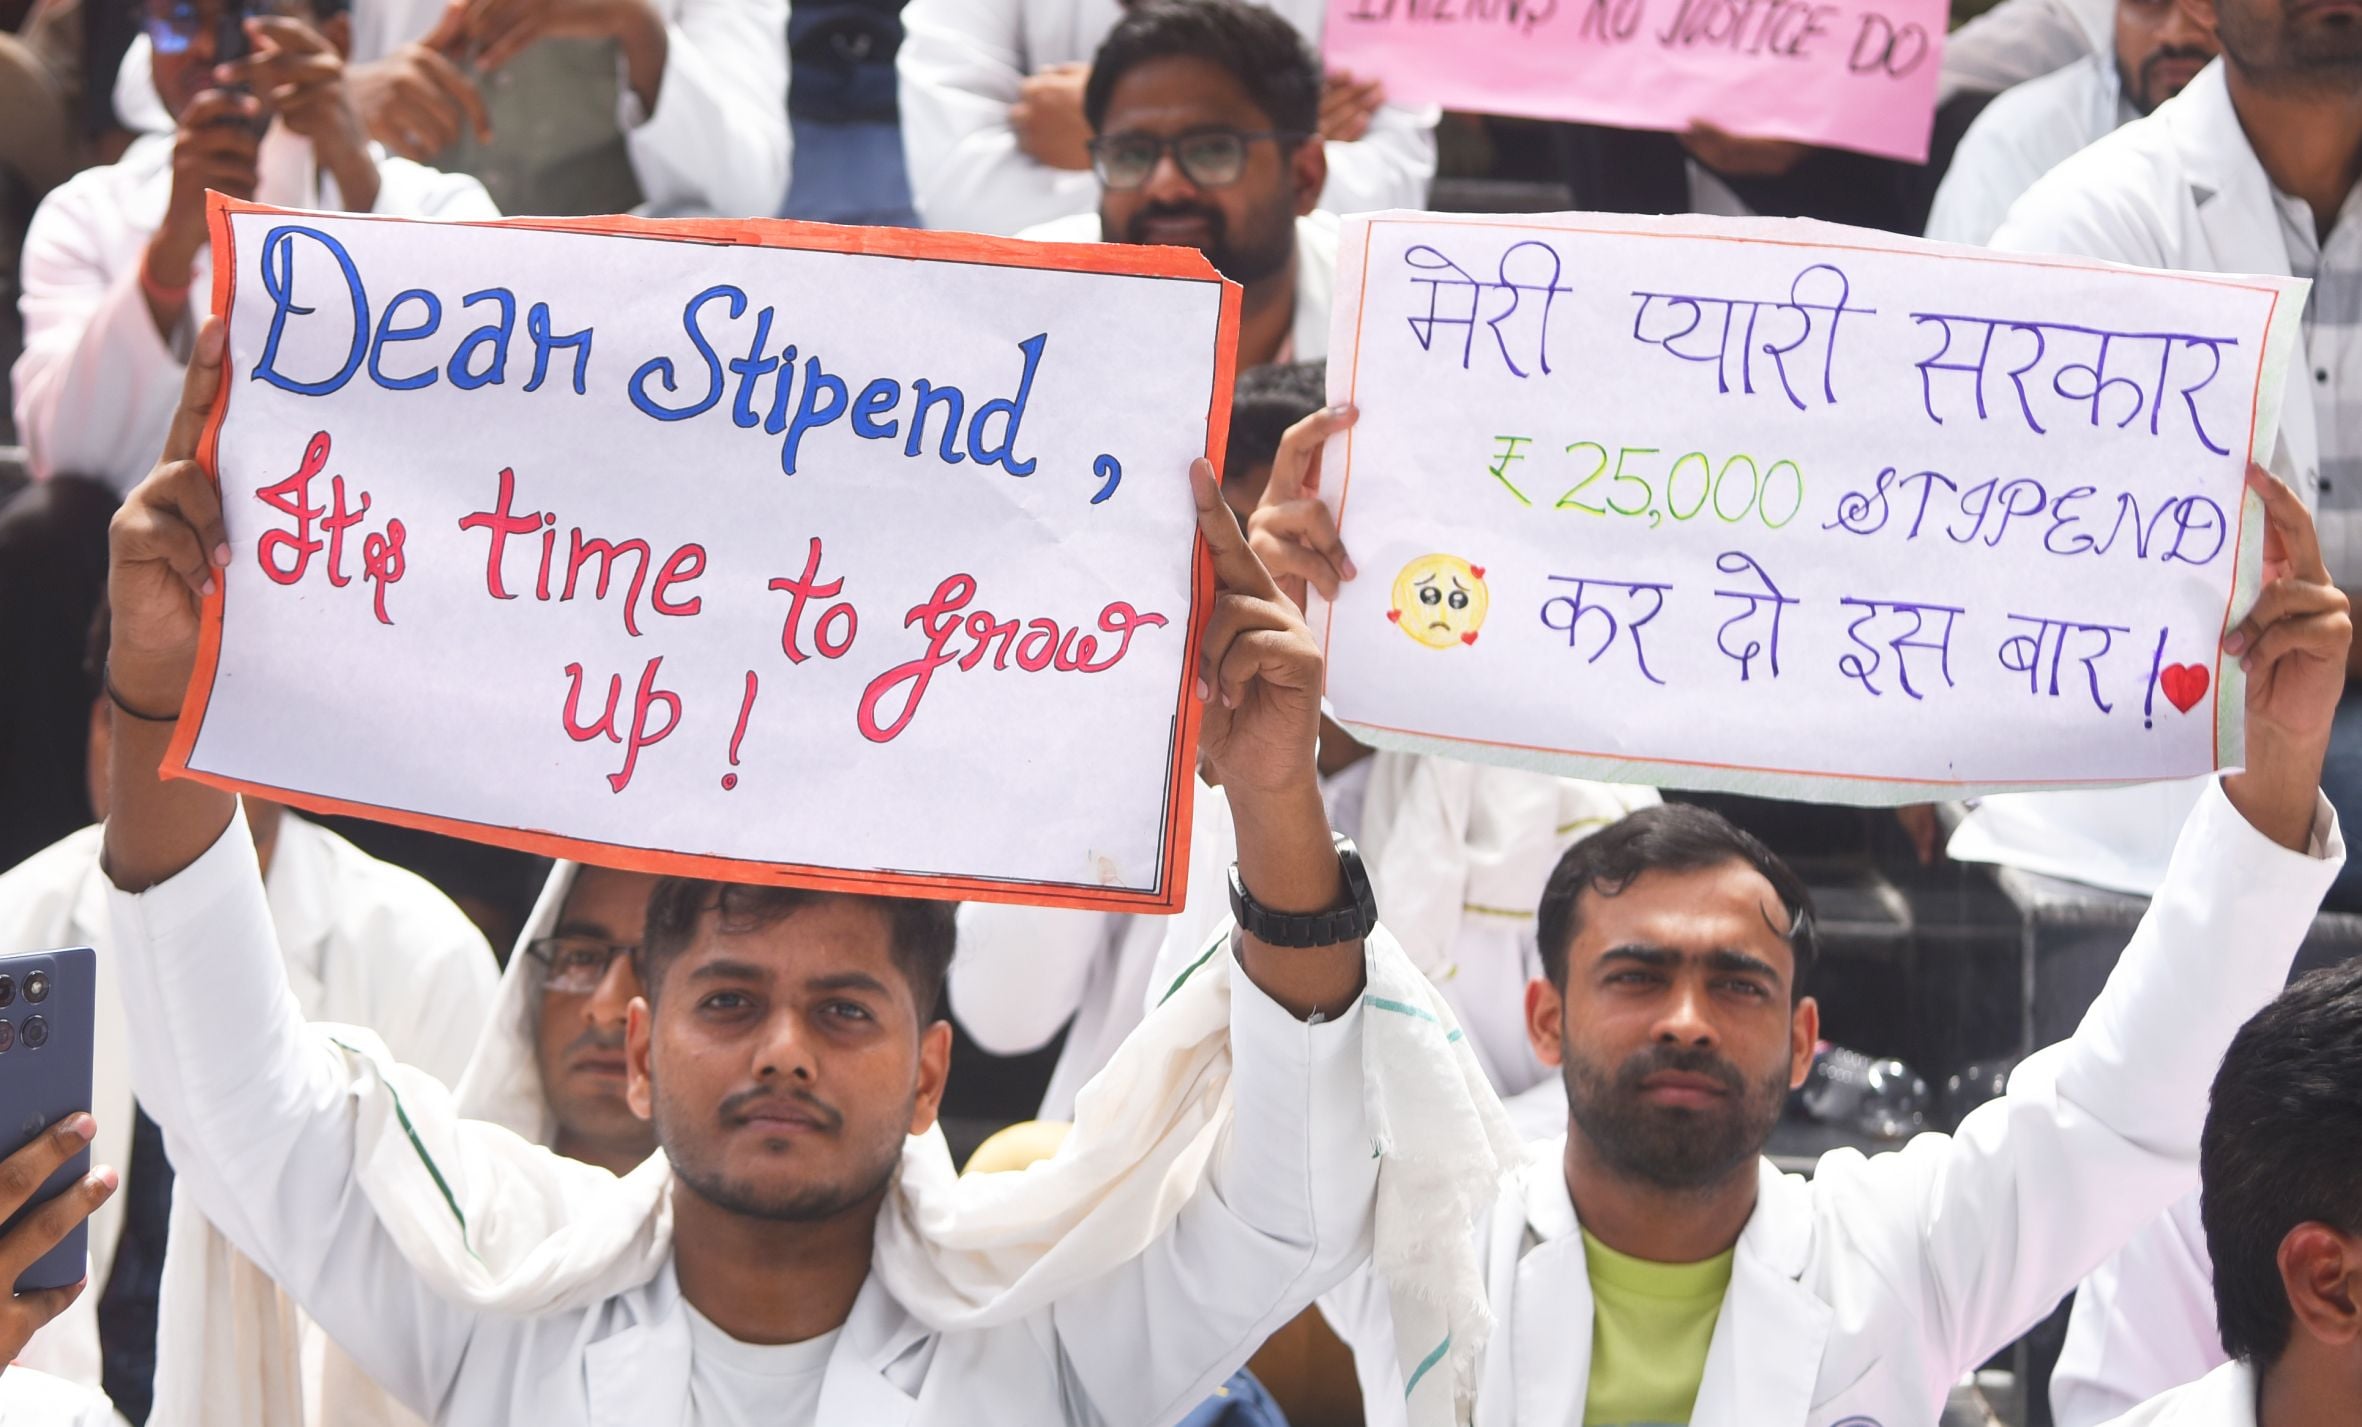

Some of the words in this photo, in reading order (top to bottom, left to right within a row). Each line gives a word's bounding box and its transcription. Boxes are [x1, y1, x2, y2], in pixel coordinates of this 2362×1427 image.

[1847, 11, 1929, 79] DO
[252, 225, 593, 397] Dear
[1405, 240, 1573, 379] मेरी
[1631, 263, 1878, 411] प्यारी
[1909, 312, 2239, 457] सरकार
[459, 467, 707, 637] time
[768, 537, 858, 664] to
[1821, 466, 2228, 566] STIPEND
[1540, 576, 1673, 684] कर
[1714, 551, 1801, 682] दो
[1838, 596, 1966, 701] इस
